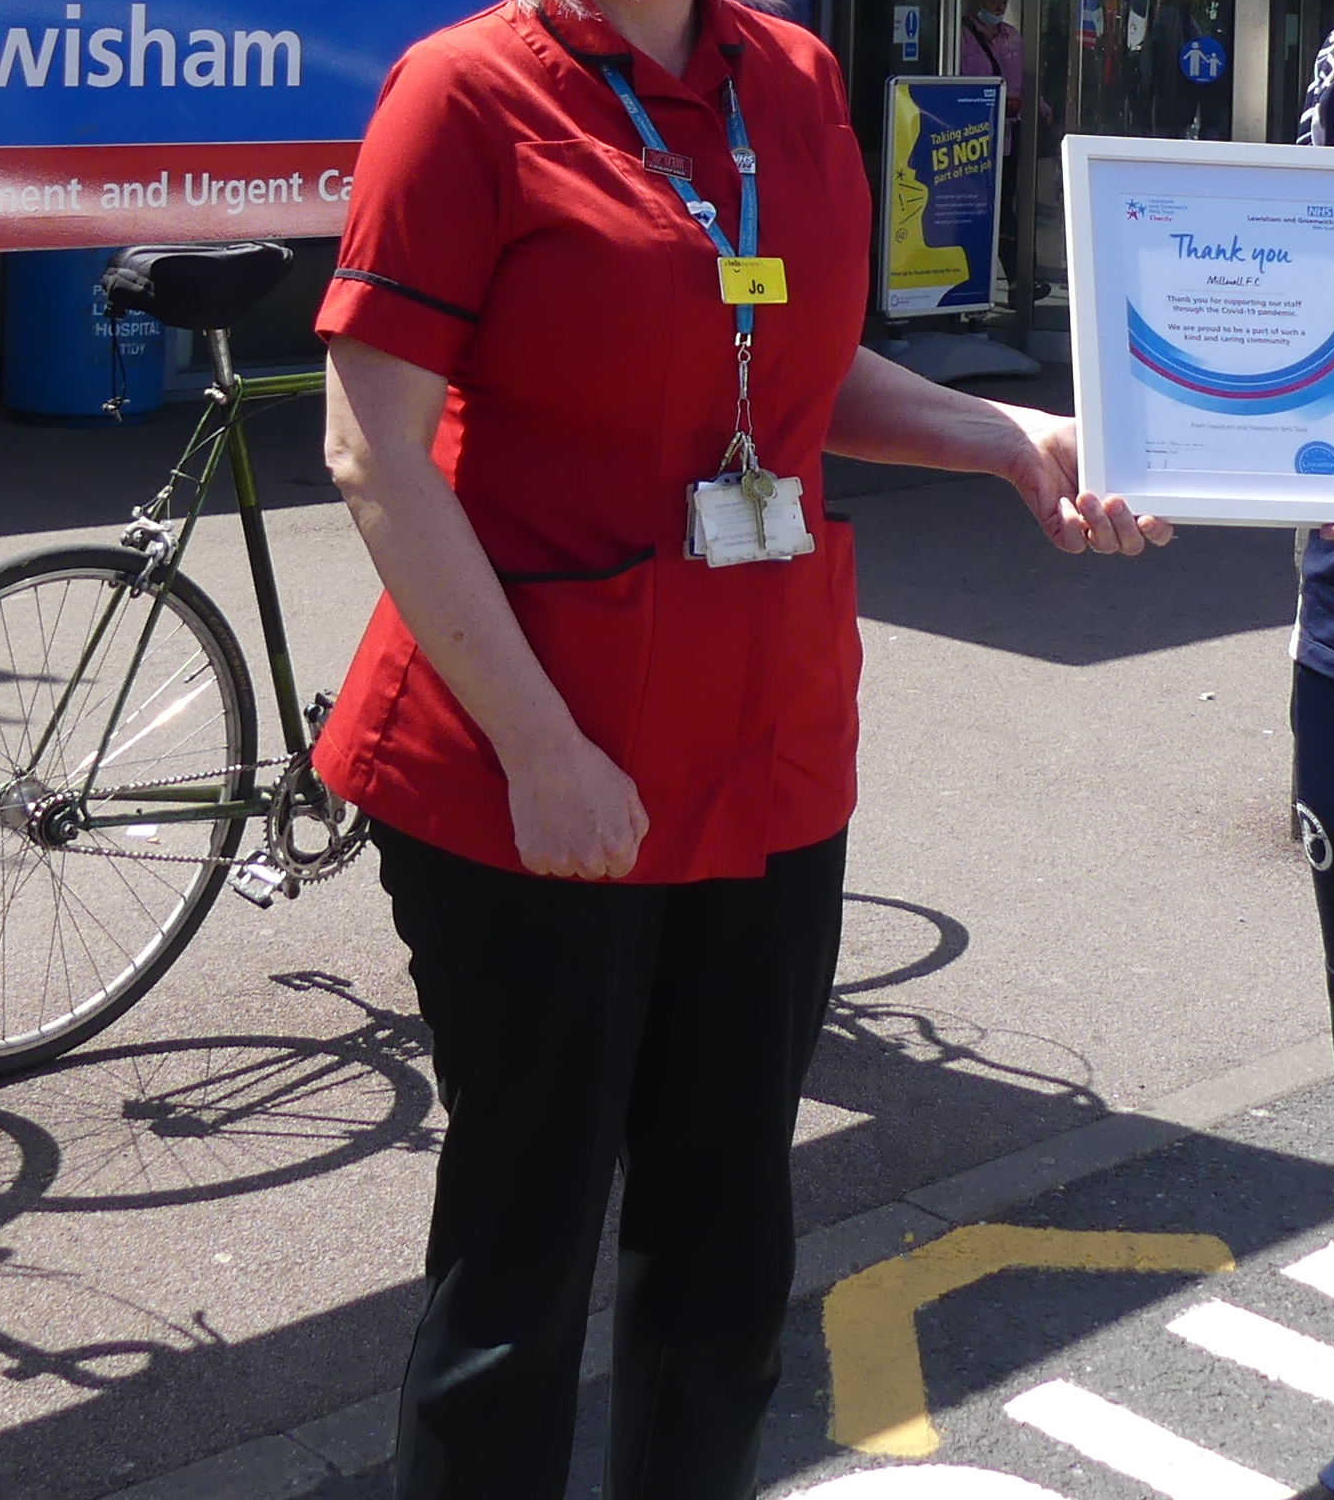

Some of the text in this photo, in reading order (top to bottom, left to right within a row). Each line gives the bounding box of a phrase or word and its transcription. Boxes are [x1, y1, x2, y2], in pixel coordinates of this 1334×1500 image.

[930, 121, 990, 145] Taking abuse
[932, 135, 990, 172] IS NOT
[933, 169, 951, 186] part
[953, 166, 963, 178] of
[964, 163, 978, 175] the
[101, 171, 169, 210] and
[183, 168, 305, 215] Urgent
[1307, 206, 1334, 217] NHS
[1169, 233, 1293, 274] Thank you
[748, 279, 764, 294] Jo
[1167, 295, 1191, 303] Thank
[1193, 297, 1208, 305] you
[1210, 296, 1222, 304] for
[1224, 298, 1267, 308] supporting
[1173, 305, 1205, 315] through
[1221, 306, 1256, 315] Covid-19
[95, 321, 161, 337] HOSPITAL
[1168, 323, 1181, 331] We
[1197, 325, 1221, 334] proud
[1233, 326, 1244, 334] be
[1252, 327, 1269, 336] part
[1281, 328, 1299, 336] such
[1183, 334, 1201, 342] kind
[120, 343, 146, 355] TIDY
